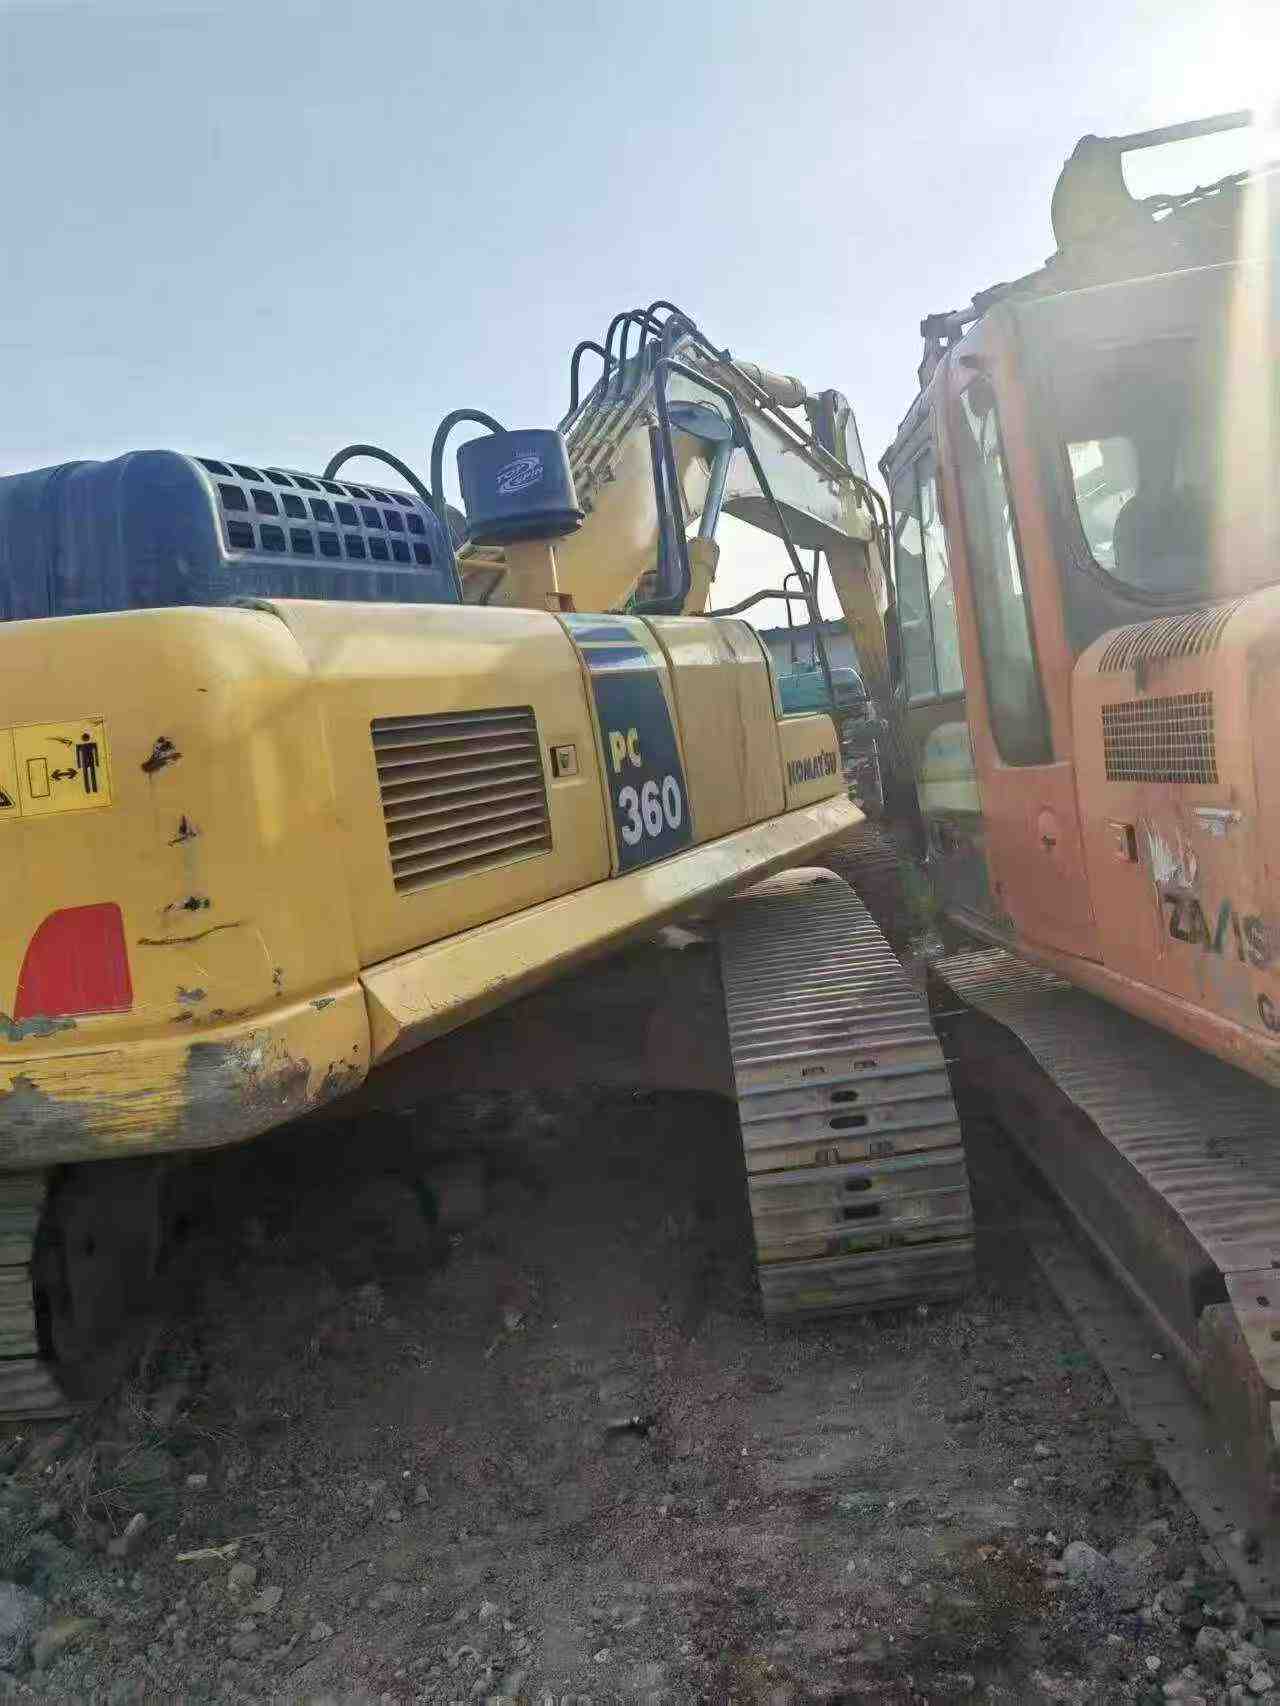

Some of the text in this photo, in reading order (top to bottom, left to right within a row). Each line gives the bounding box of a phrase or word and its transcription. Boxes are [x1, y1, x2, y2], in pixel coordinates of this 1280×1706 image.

[608, 727, 641, 773] PC
[786, 751, 837, 786] KOMATSU
[618, 775, 682, 846] 360
